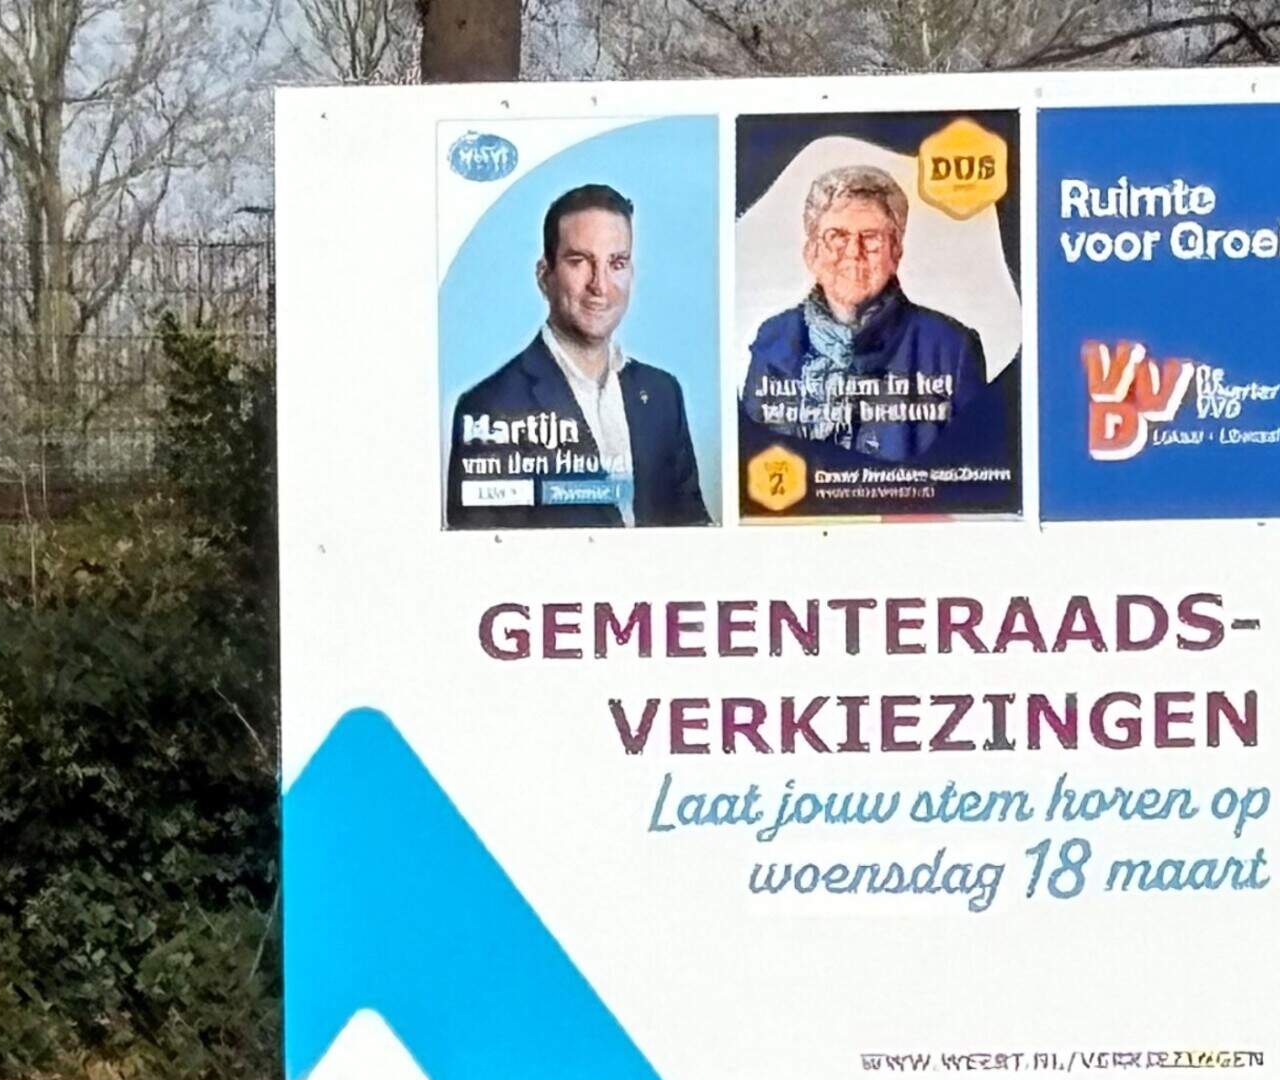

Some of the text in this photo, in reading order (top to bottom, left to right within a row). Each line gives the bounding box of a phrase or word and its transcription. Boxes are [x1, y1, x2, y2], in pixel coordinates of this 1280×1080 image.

[930, 155, 996, 181] DUS
[1060, 176, 1216, 218] Ruimte
[1059, 231, 1160, 262] voor
[463, 411, 579, 449] Martijn
[478, 594, 1260, 660] GEMEENTERAADS-
[608, 690, 1259, 754] VERKIEZINGEN
[648, 774, 1272, 842] Laat jouw stem horen op
[748, 838, 1272, 912] woensdag 18 maart
